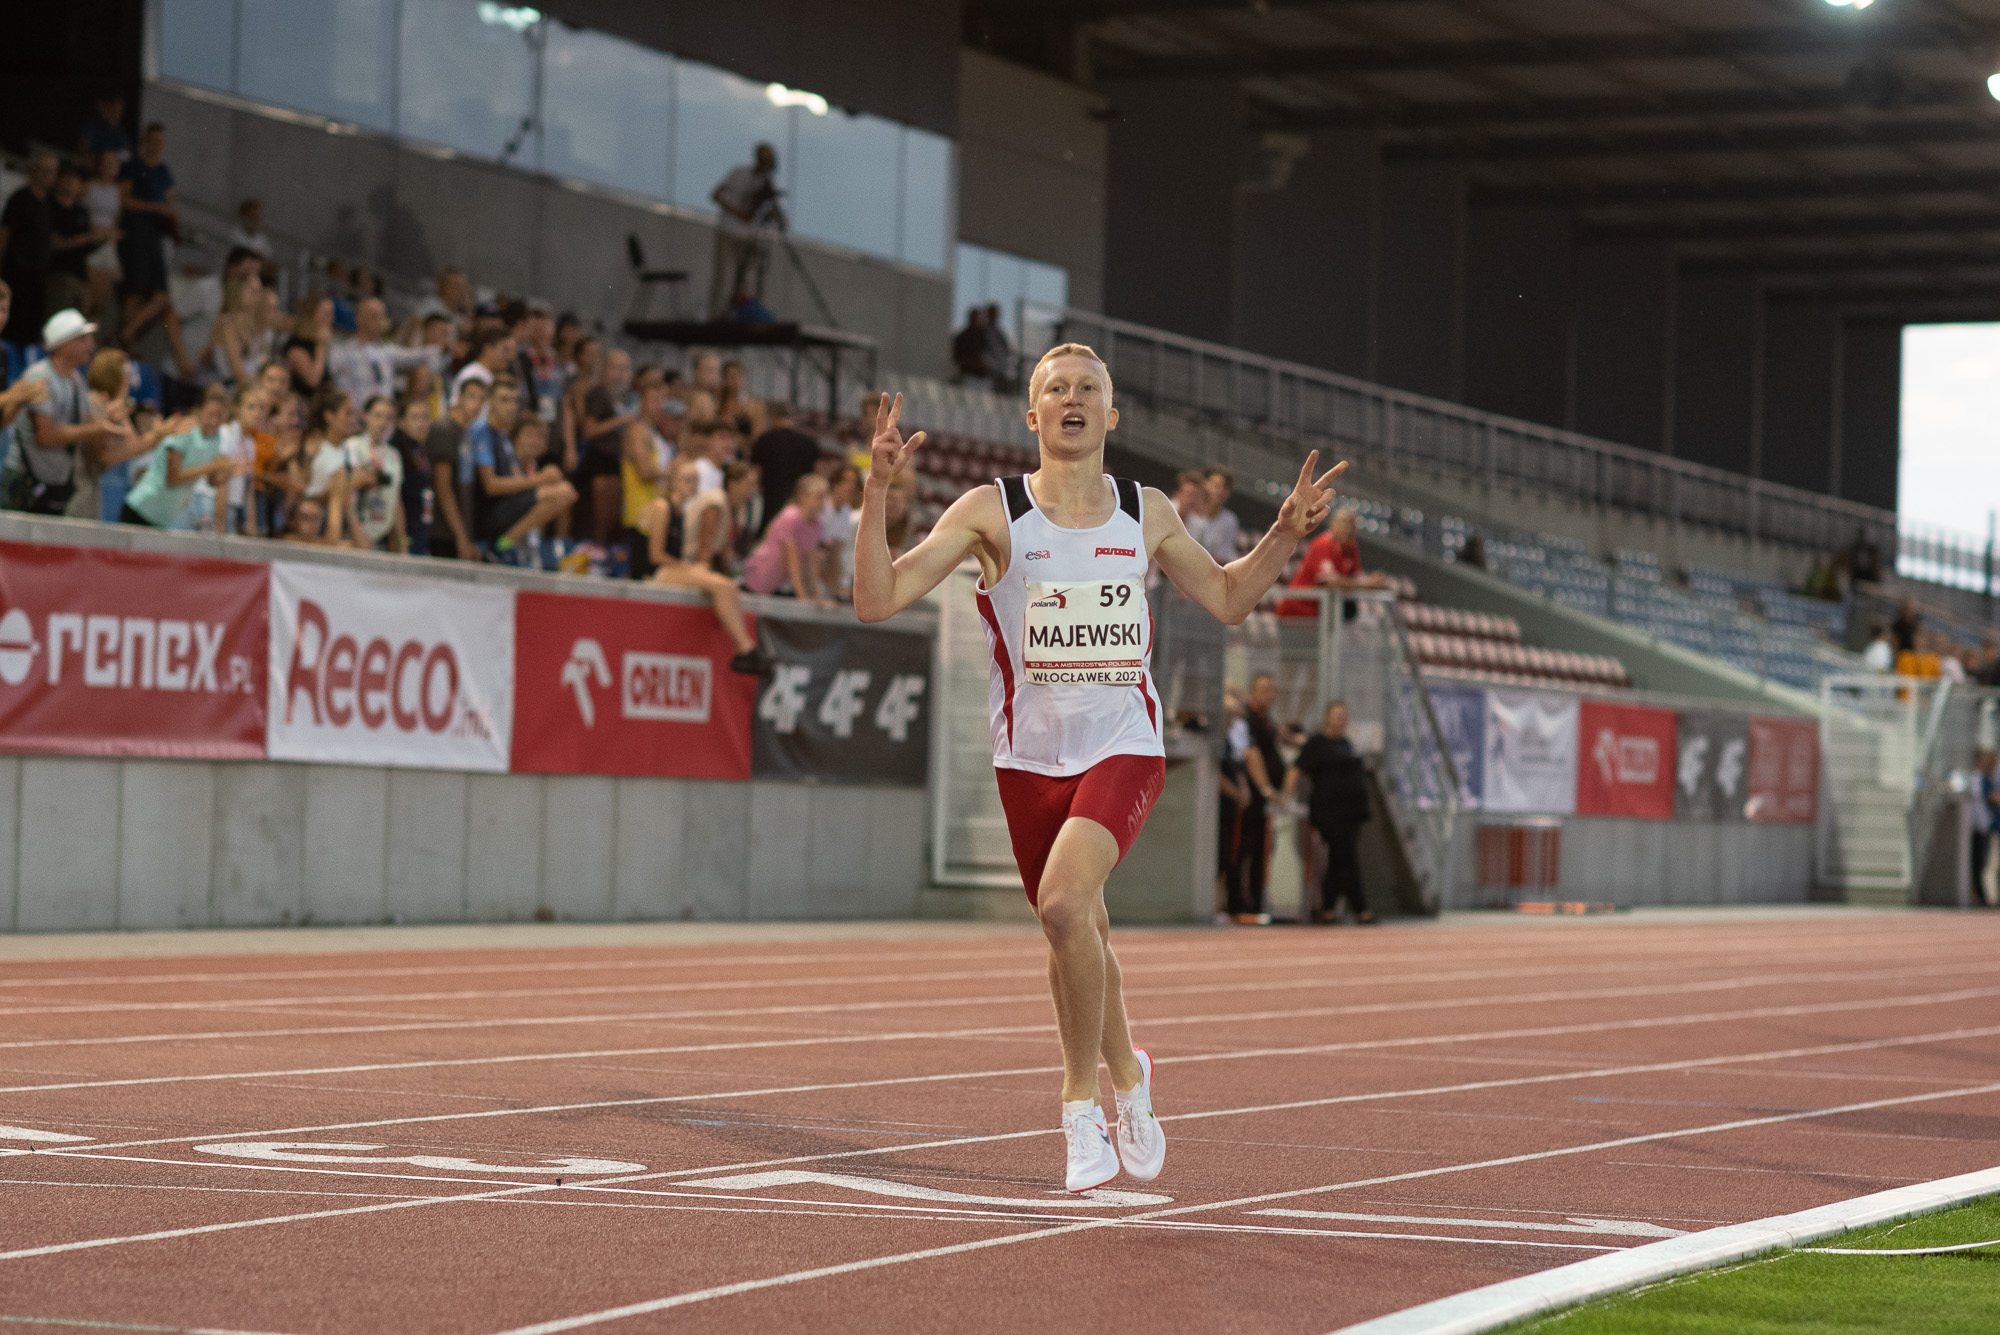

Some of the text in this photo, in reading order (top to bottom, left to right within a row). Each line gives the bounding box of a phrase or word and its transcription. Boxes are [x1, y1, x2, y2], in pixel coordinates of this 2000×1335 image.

[1030, 600, 1058, 609] polanik
[1099, 584, 1131, 607] 59
[1029, 623, 1141, 648] MAJEWSKI
[1032, 671, 1142, 683] WŁOCŁAWEK 2021
[818, 668, 871, 738] 4F
[874, 674, 926, 742] 4F
